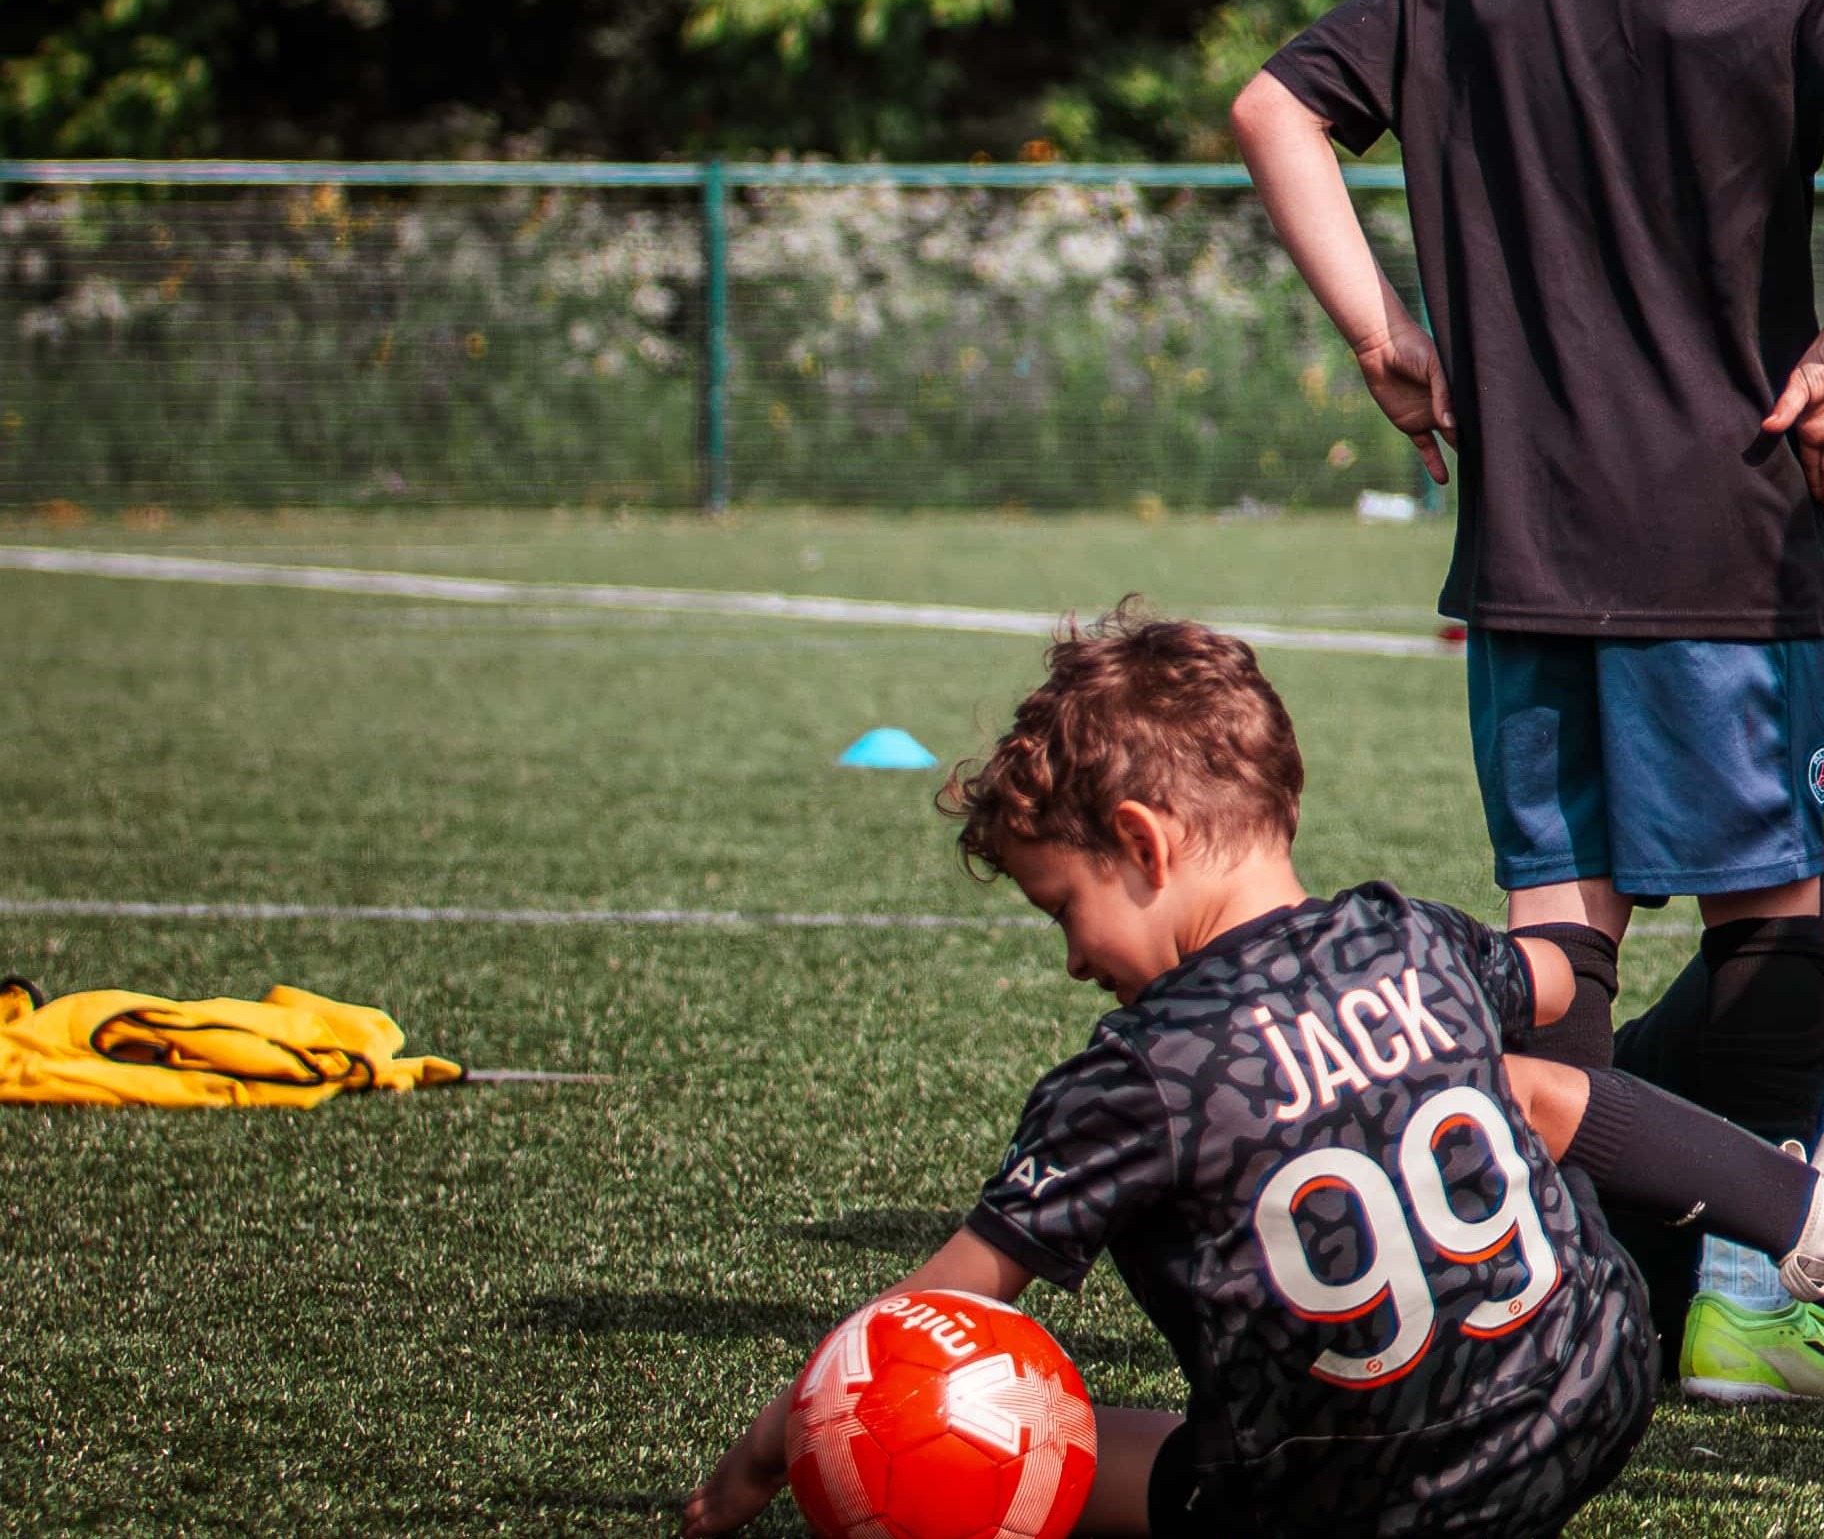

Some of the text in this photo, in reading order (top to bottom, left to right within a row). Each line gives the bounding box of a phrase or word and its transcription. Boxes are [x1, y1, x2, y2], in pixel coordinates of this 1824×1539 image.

[1253, 968, 1456, 1122] JACK
[1255, 1085, 1562, 1391] 99
[879, 1297, 977, 1357] mitre
